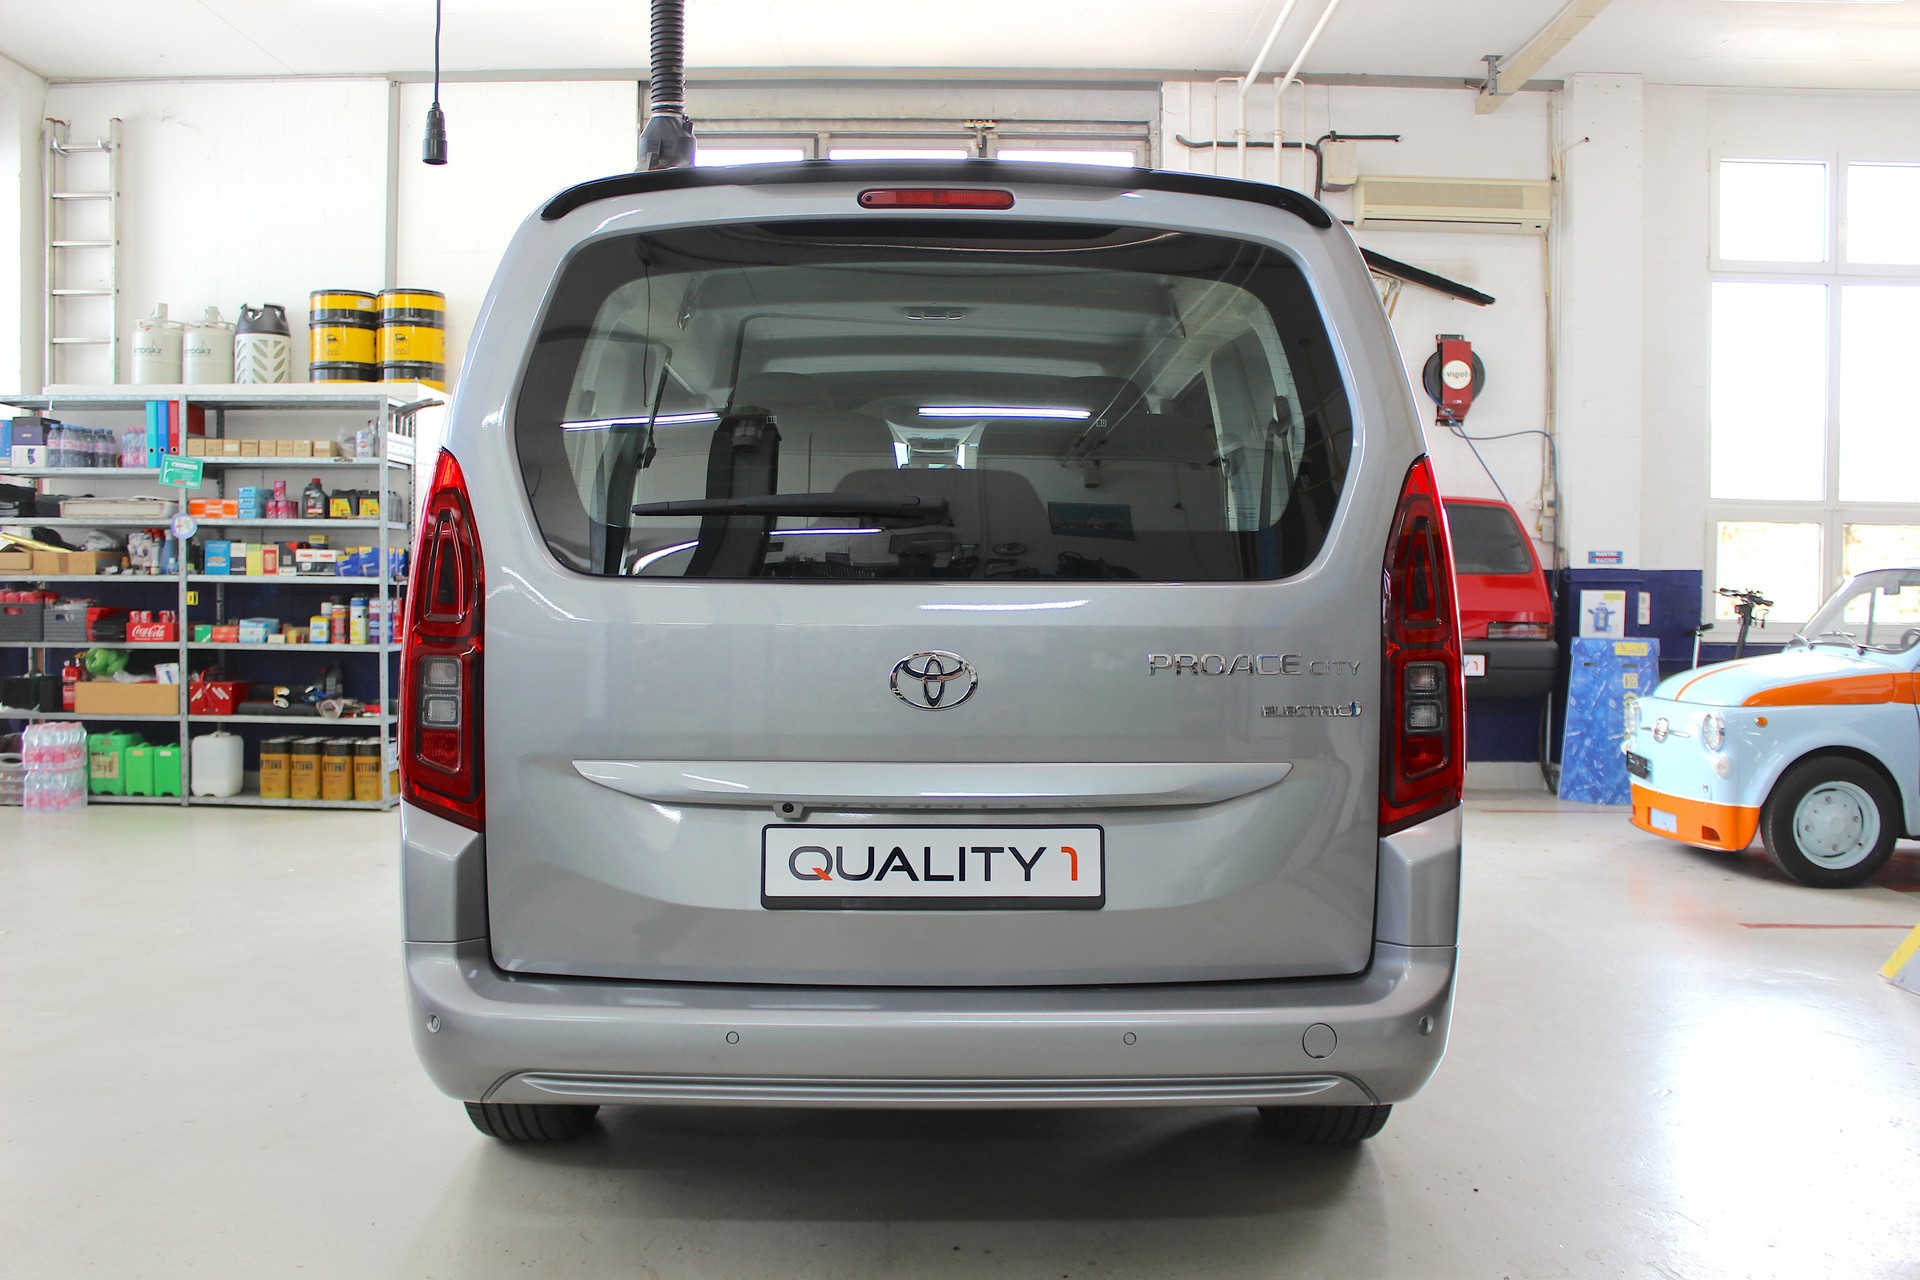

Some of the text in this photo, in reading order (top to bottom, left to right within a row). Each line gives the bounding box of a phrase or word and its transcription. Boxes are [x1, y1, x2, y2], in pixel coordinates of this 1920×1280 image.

[1148, 653, 1361, 676] PROACE CITY
[1261, 704, 1354, 717] ELECTRIC
[788, 845, 1079, 882] QUALITY 1
